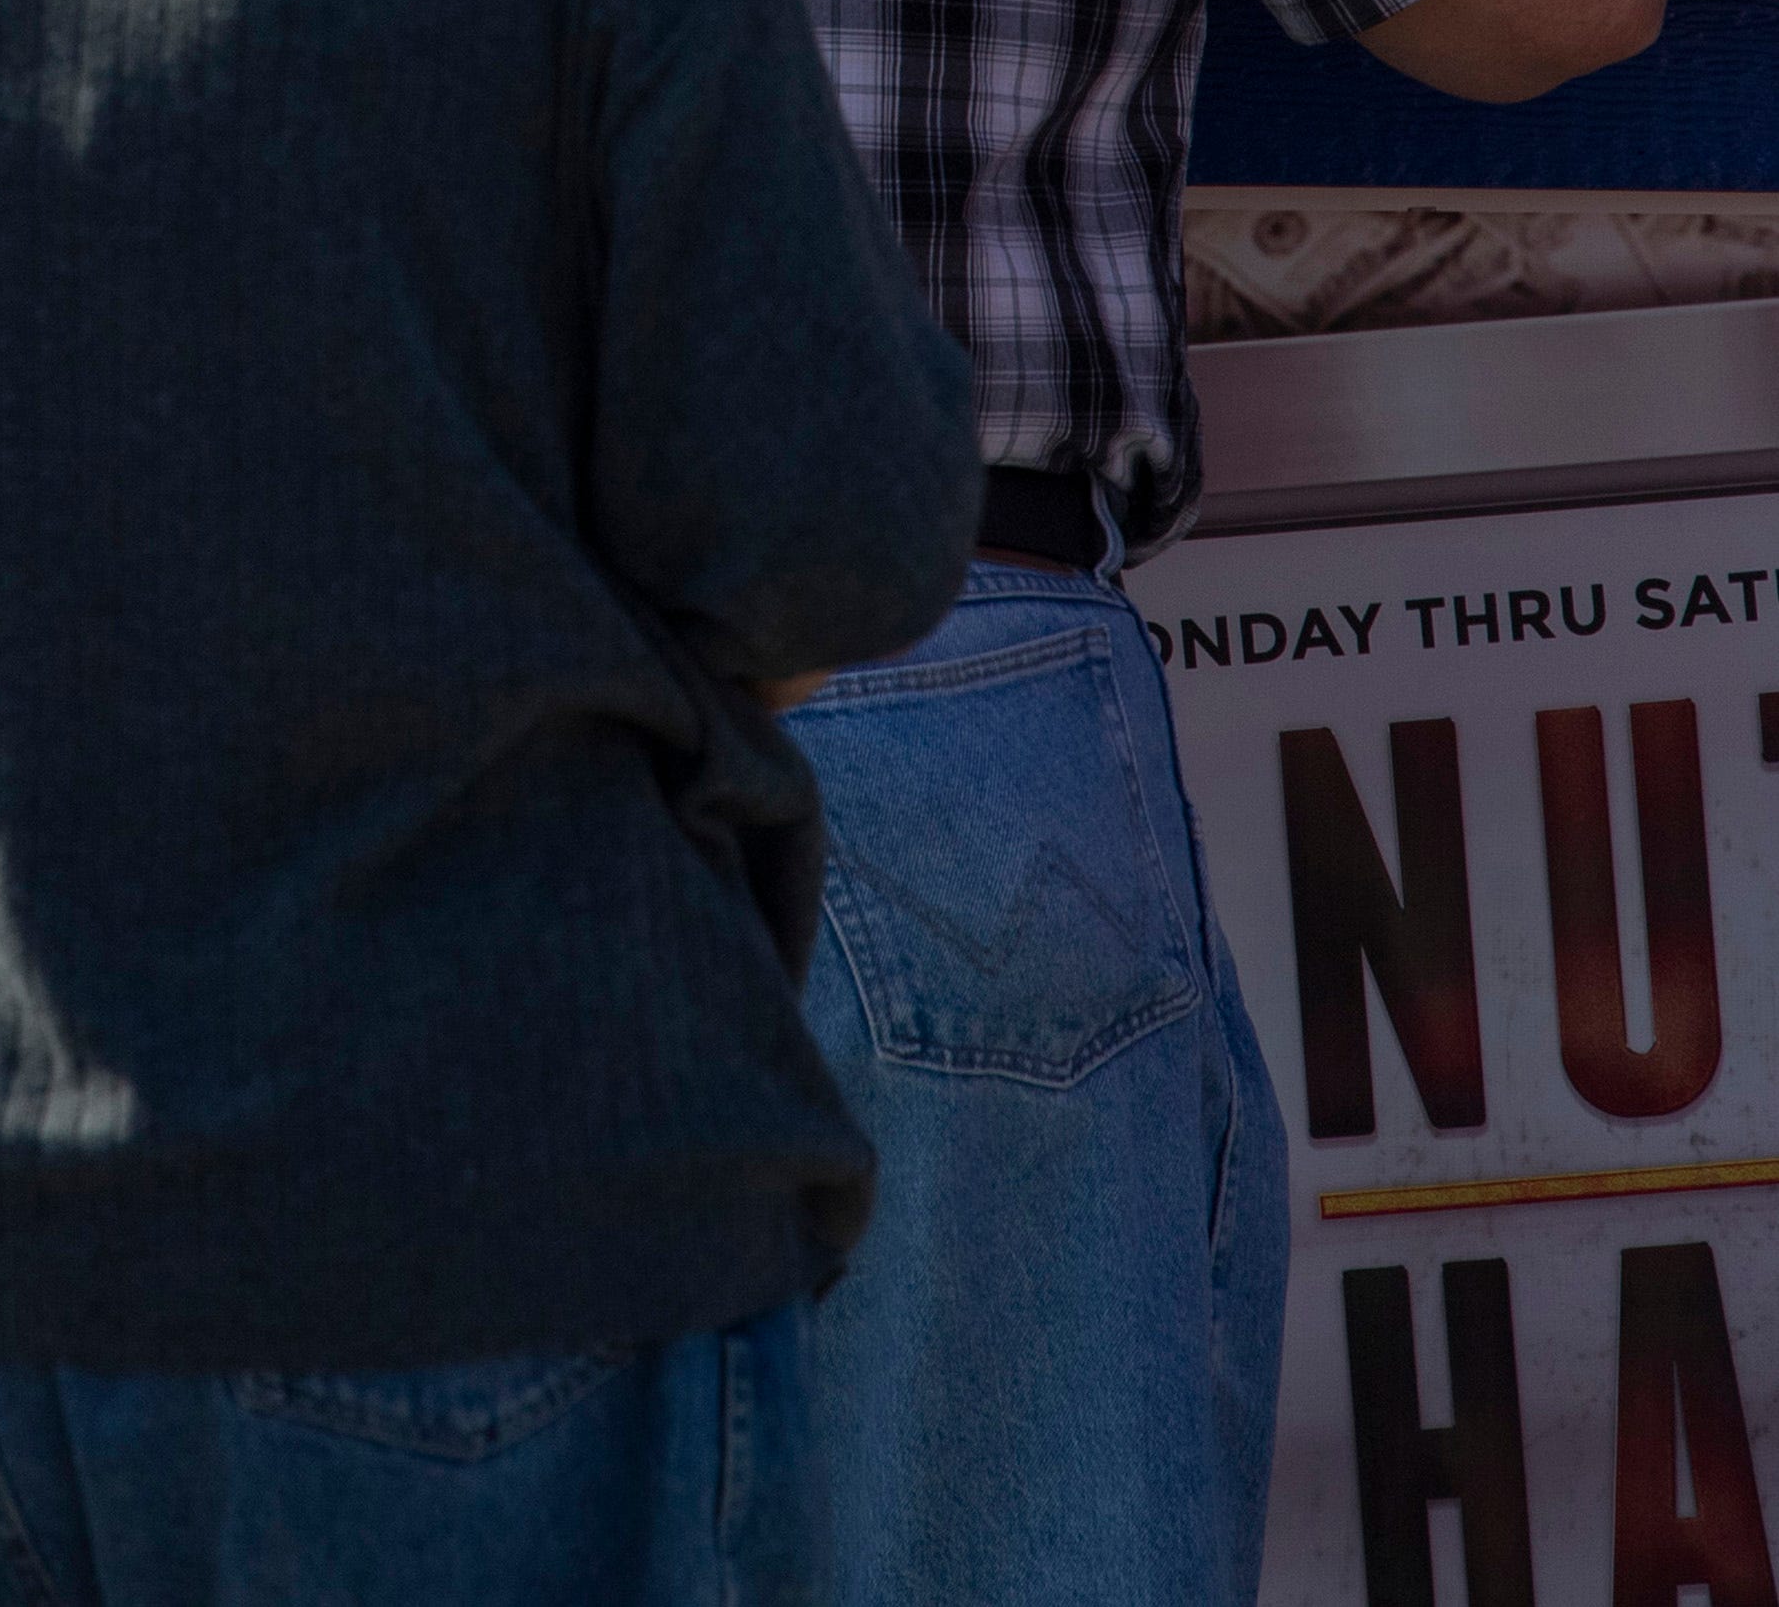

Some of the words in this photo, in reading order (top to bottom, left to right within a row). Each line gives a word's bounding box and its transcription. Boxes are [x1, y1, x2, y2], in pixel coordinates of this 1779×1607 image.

[1405, 583, 1607, 649] THRU
[1635, 568, 1779, 630] SAT
[1279, 690, 1779, 1141] NU
